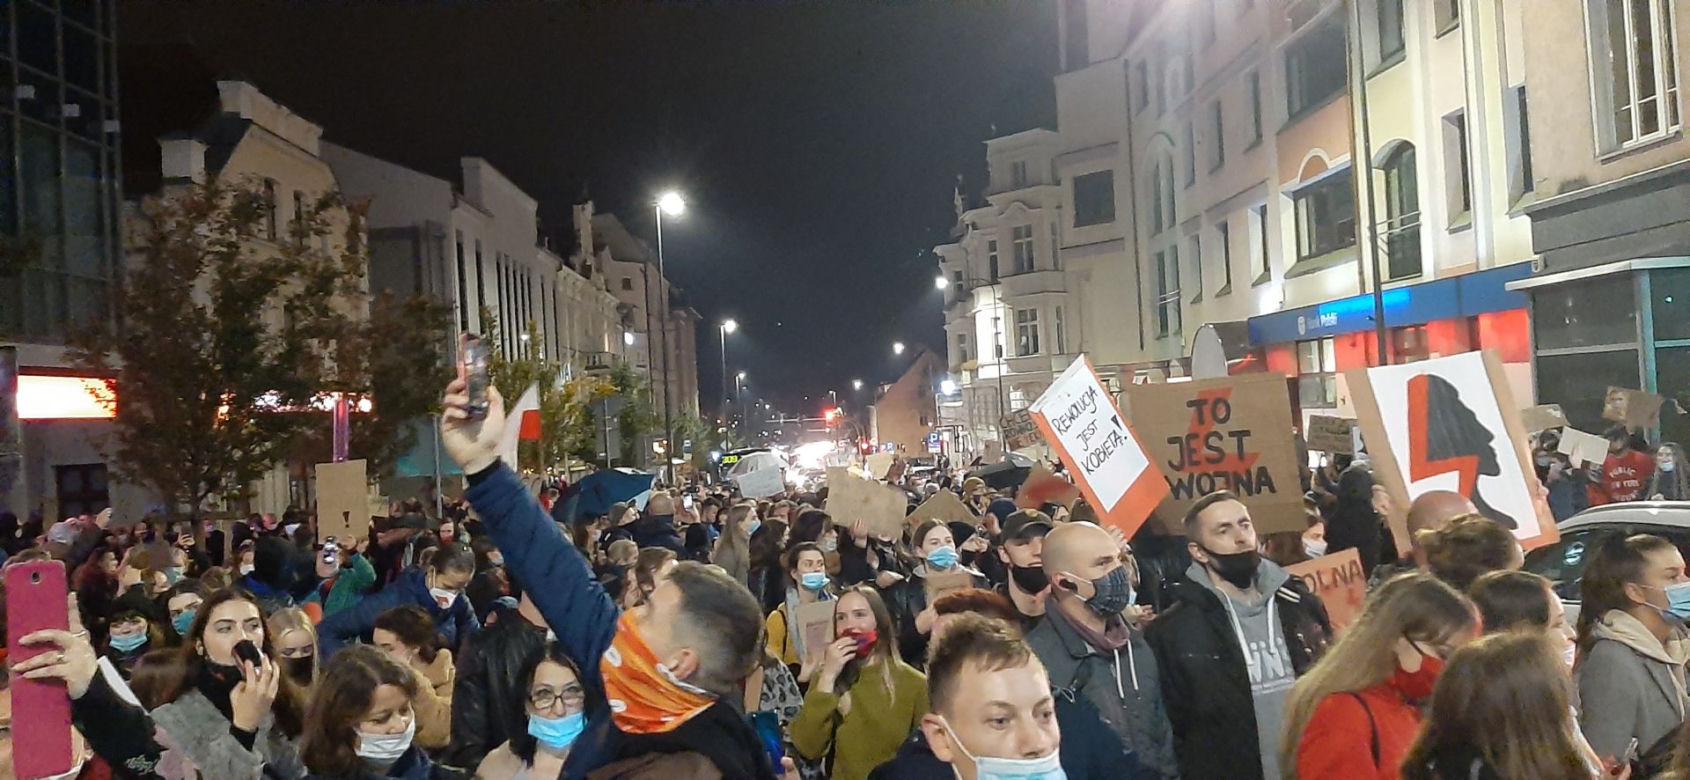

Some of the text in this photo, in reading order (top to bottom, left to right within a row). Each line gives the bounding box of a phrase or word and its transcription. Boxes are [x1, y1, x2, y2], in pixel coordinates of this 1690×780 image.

[1186, 397, 1232, 426] TO
[1075, 418, 1099, 453] JEST
[1166, 429, 1252, 472] JEST
[342, 511, 350, 528] !
[1303, 560, 1364, 594] OLNA
